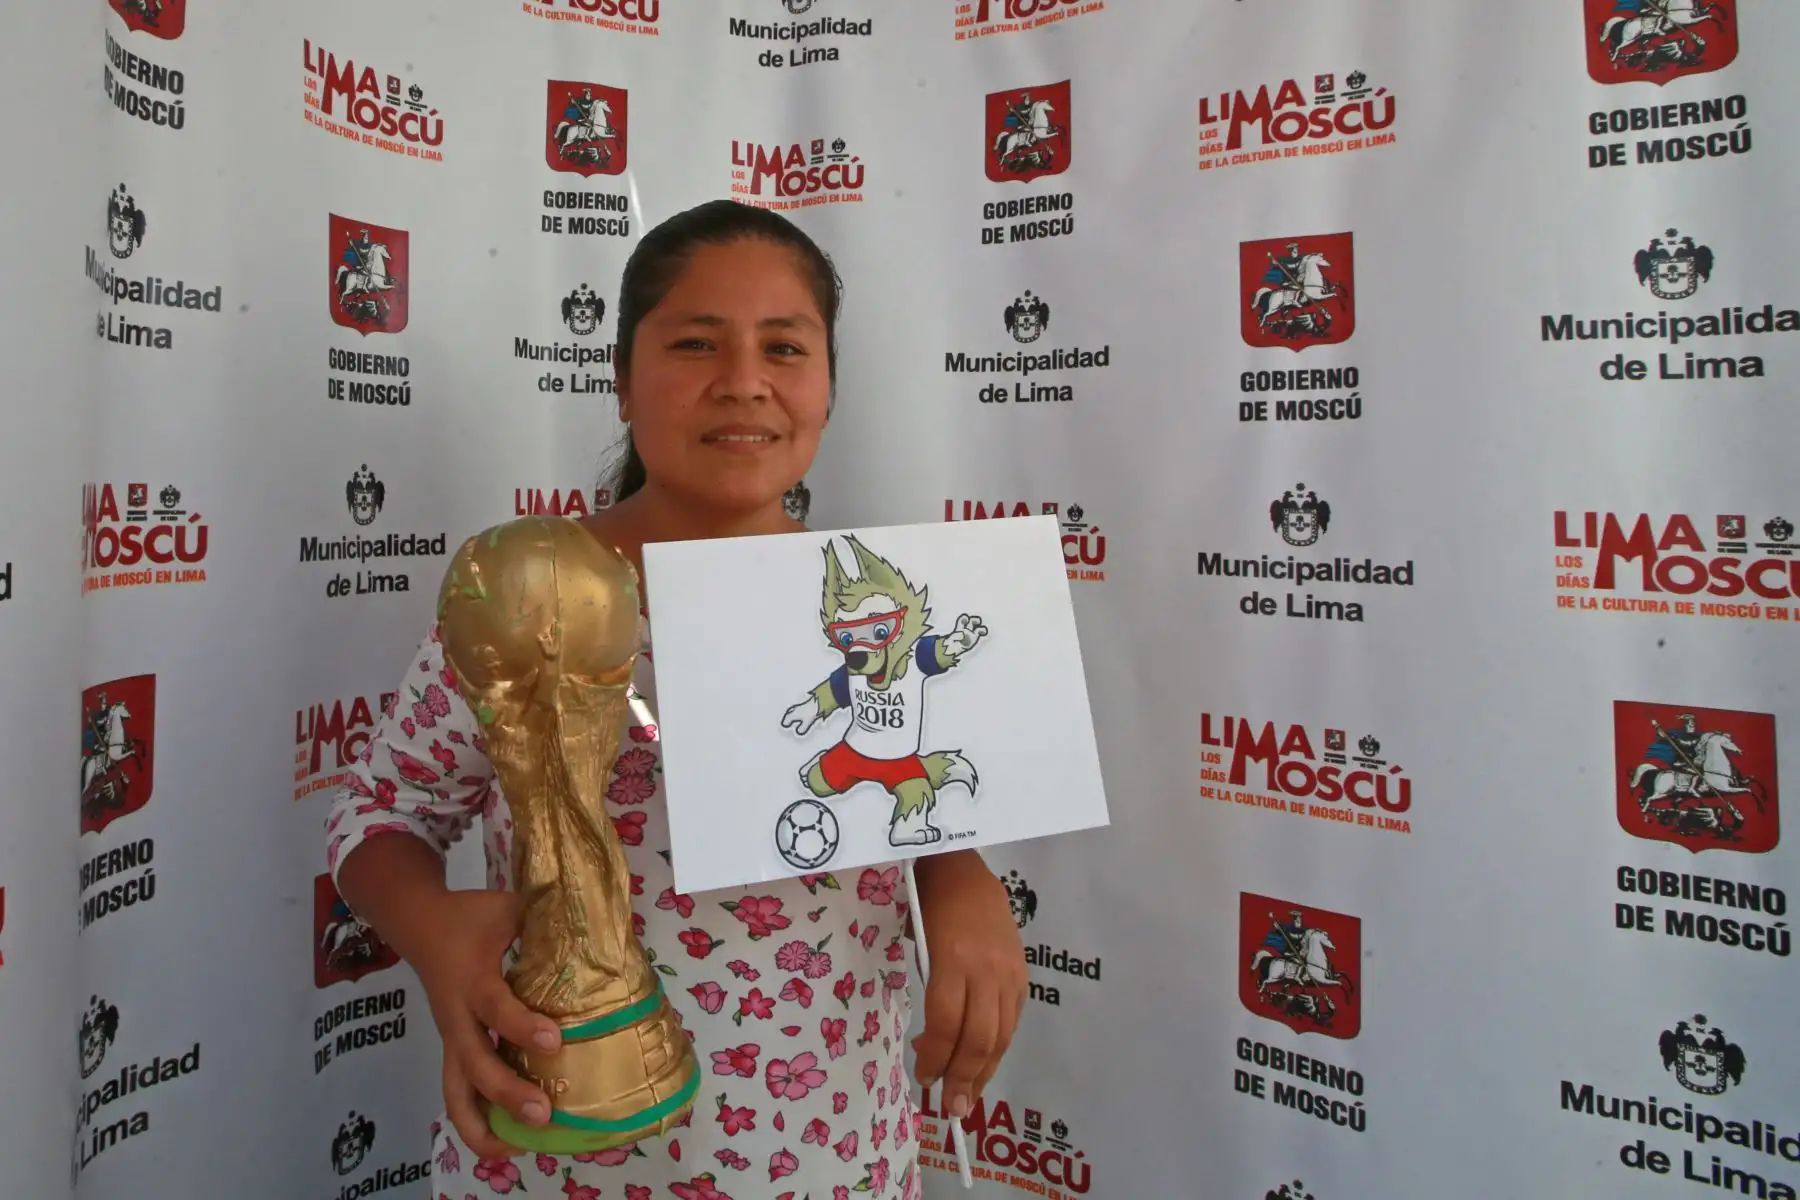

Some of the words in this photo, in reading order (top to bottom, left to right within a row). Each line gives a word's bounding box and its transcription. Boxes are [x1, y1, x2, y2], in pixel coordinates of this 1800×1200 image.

[955, 4, 971, 14] LOS
[955, 31, 966, 41] DE
[968, 28, 978, 38] LA
[980, 24, 1018, 36] CULTURA
[1022, 20, 1032, 30] DE
[1035, 11, 1064, 27] MOSCÚ
[1067, 8, 1078, 18] EN
[1081, 2, 1104, 15] LIMA
[955, 16, 975, 28] DÍAS
[730, 16, 872, 42] Municipalidad
[758, 50, 783, 67] de
[790, 46, 839, 66] Lima
[304, 38, 381, 118] LIMA
[304, 76, 317, 91] LOS
[114, 80, 184, 129] MOSCÚ
[1199, 79, 1307, 143] LIMA
[1589, 94, 1747, 135] GOBIERNO
[304, 109, 312, 122] DE
[314, 114, 323, 128] LA
[324, 119, 360, 142] CULTURA
[362, 134, 374, 146] DE
[376, 137, 405, 155] MOSCÚ
[408, 146, 418, 158] EN
[421, 149, 443, 162] LIMA
[1199, 128, 1218, 141] LOS
[1199, 142, 1225, 156] DÍAS
[1589, 143, 1627, 168] DE
[1637, 122, 1752, 165] MOSCÚ
[732, 140, 806, 188] LIMA
[1199, 159, 1212, 170] DE
[1216, 156, 1228, 168] LA
[1232, 149, 1281, 165] CULTURA
[1284, 146, 1298, 158] DE
[1302, 139, 1343, 156] MOSCÚ
[1347, 138, 1362, 150] EN
[1366, 132, 1396, 148] LIMA
[732, 170, 744, 180] LOS
[544, 190, 628, 212] GOBIERNO
[984, 192, 1073, 220] GOBIERNO
[542, 214, 562, 234] DE
[568, 216, 629, 237] MOSCÚ
[982, 227, 1004, 244] DE
[1010, 212, 1074, 243] MOSCÚ
[108, 312, 172, 349] Lima
[1541, 304, 1800, 344] Municipalida
[328, 347, 410, 377] GOBIERNO
[514, 337, 617, 367] Municipal
[945, 345, 1109, 376] Municipalidad
[1600, 354, 1647, 380] de
[1659, 352, 1764, 380] Lima
[328, 378, 344, 400] DE
[350, 380, 410, 406] MOSCÚ
[538, 373, 564, 392] de
[979, 384, 1008, 403] de
[1015, 382, 1073, 402] Lima
[1240, 366, 1359, 392] GOBIERNO
[1239, 401, 1268, 422] DE
[1276, 392, 1362, 421] MOSCÚ
[300, 533, 446, 564] Municipalidad
[1554, 511, 1706, 583] LIMA
[1556, 556, 1582, 568] LOS
[101, 575, 110, 588] DE
[113, 568, 152, 587] MOSCÚ
[156, 570, 171, 584] EN
[176, 569, 206, 582] LIMA
[327, 573, 350, 598] de
[356, 570, 409, 594] Lima
[1080, 570, 1104, 581] LIMA
[1198, 552, 1414, 586] Municipalidad
[1556, 573, 1590, 588] DÍAS
[1240, 592, 1277, 616] de
[1286, 593, 1364, 622] Lima
[1557, 596, 1574, 608] DE
[1580, 597, 1598, 610] LA
[1602, 598, 1669, 614] CULTURA
[1676, 602, 1694, 615] DE
[1701, 602, 1760, 619] MOSCÚ
[1766, 607, 1788, 621] EN
[855, 688, 905, 706] RUSSIA
[857, 702, 904, 728] 2018
[296, 696, 374, 766] LIMA
[1201, 713, 1315, 782] LIMA
[1201, 752, 1220, 764] LOS
[1201, 767, 1225, 782] DÍAS
[1201, 786, 1214, 798] DE
[1217, 790, 1231, 802] LA
[1235, 792, 1286, 811] CULTURA
[1290, 802, 1304, 814] DE
[1310, 806, 1353, 824] MOSCÚ
[1357, 813, 1373, 826] EN
[1378, 816, 1411, 833] LIMA
[80, 838, 154, 894] BIERNO
[83, 868, 156, 930] MOSCÚ
[1617, 865, 1786, 916] GOBIERNO
[1616, 903, 1654, 932] DE
[1666, 910, 1791, 957] MOSCÚ
[315, 988, 406, 1041] GOBIERNO
[315, 1042, 332, 1075] DE
[336, 1012, 406, 1058] MOSCÚ
[1237, 1037, 1364, 1096] GOBIERNO
[1234, 1069, 1265, 1100] DE
[1274, 1080, 1366, 1132] MOSCÚ
[1561, 1080, 1800, 1162] Municipalid
[81, 1112, 149, 1171] Lima
[1620, 1140, 1671, 1174] de
[1684, 1150, 1797, 1200] Lima
